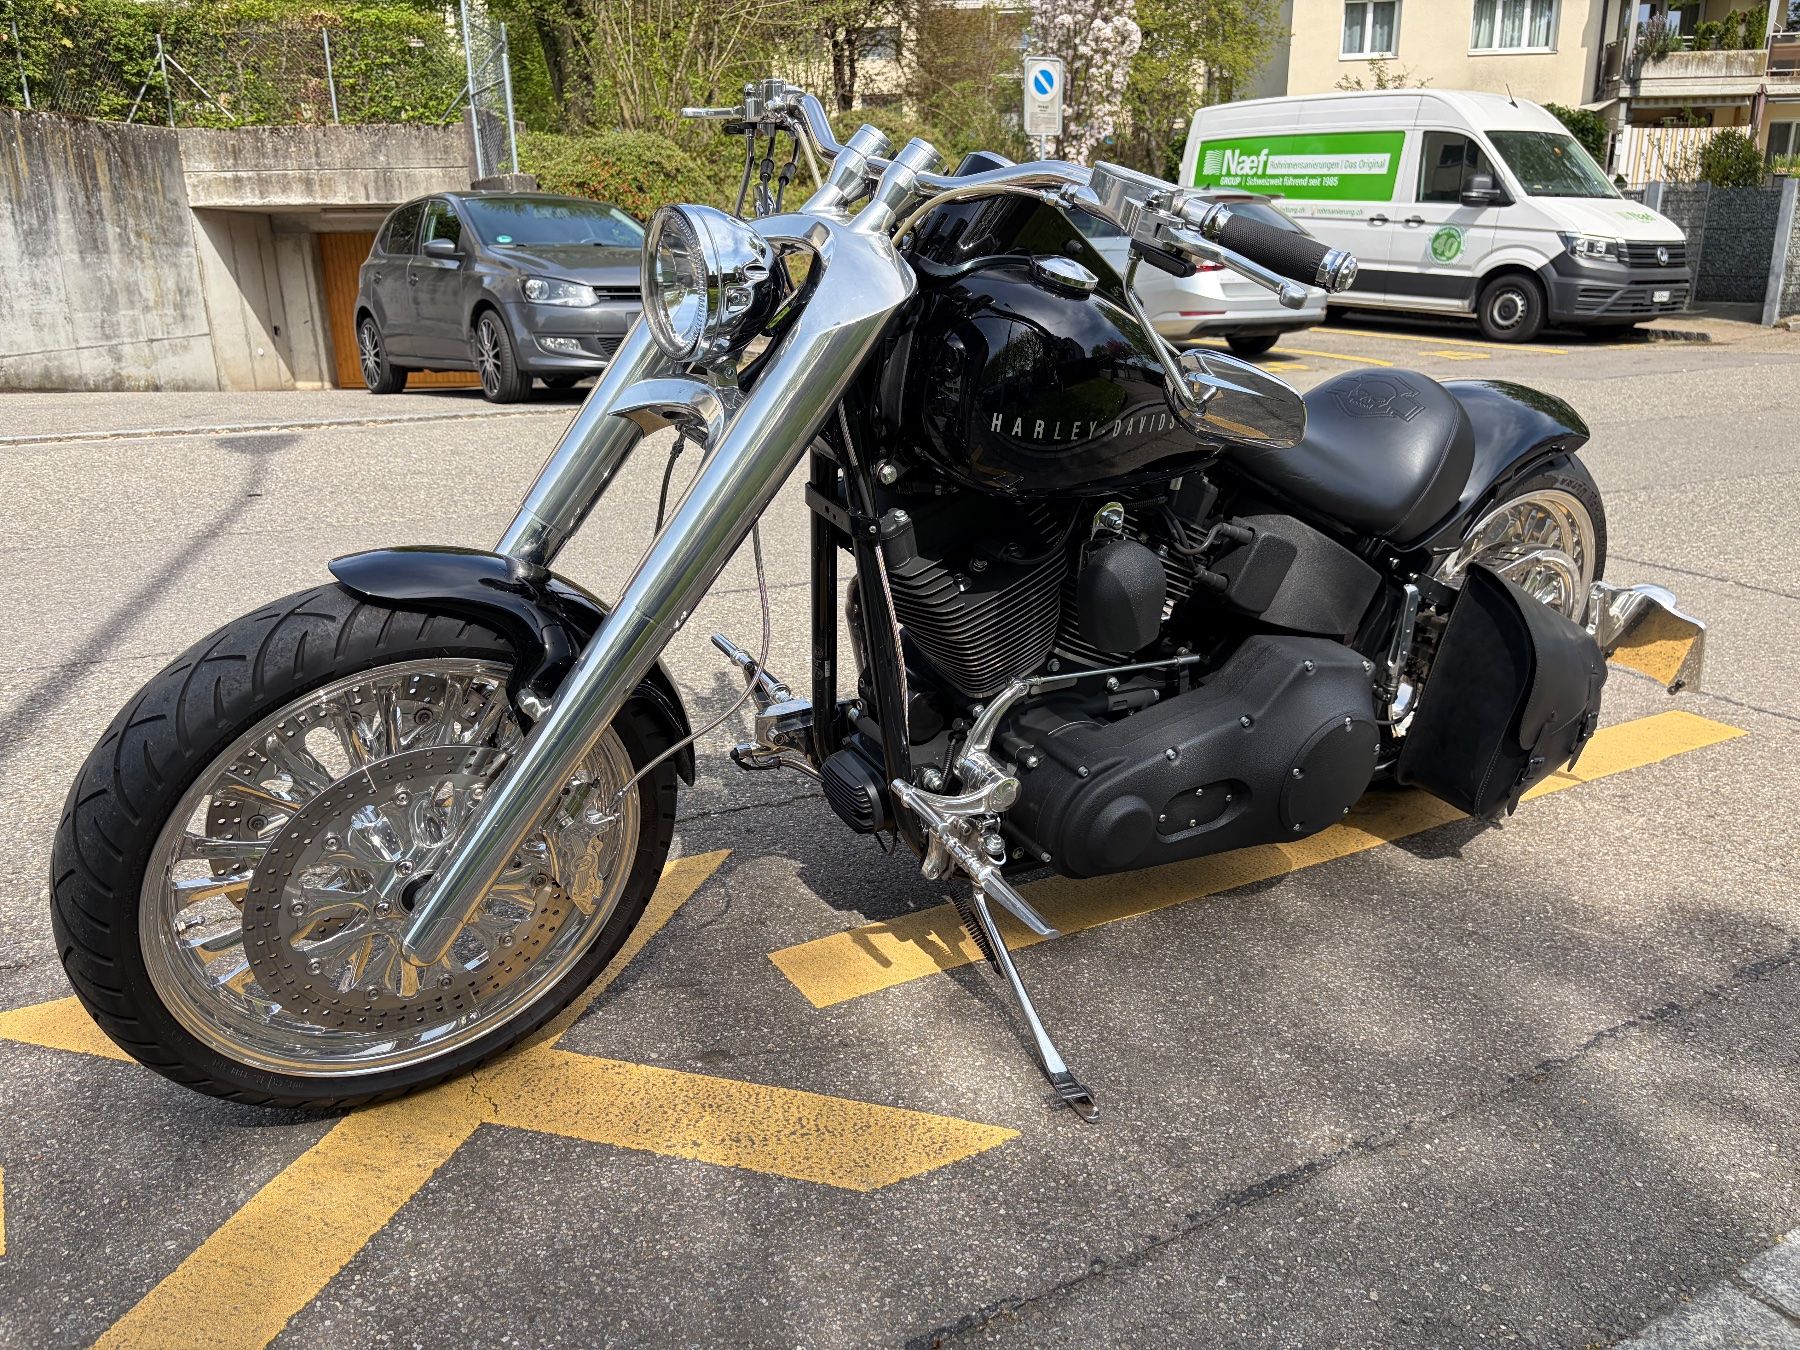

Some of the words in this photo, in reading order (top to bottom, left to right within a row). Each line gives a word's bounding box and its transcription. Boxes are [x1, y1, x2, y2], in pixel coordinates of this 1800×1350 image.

[1221, 148, 1269, 175] Naef
[1269, 159, 1340, 172] Rohrinnensanierungen
[1344, 158, 1357, 169] Das
[1359, 158, 1387, 171] Original
[1220, 176, 1241, 186] GROUP
[1246, 176, 1282, 186] Schweizweit
[1283, 176, 1307, 187] führend
[1308, 176, 1321, 186] seit
[1322, 176, 1339, 187] 1985
[1433, 234, 1459, 258] 40
